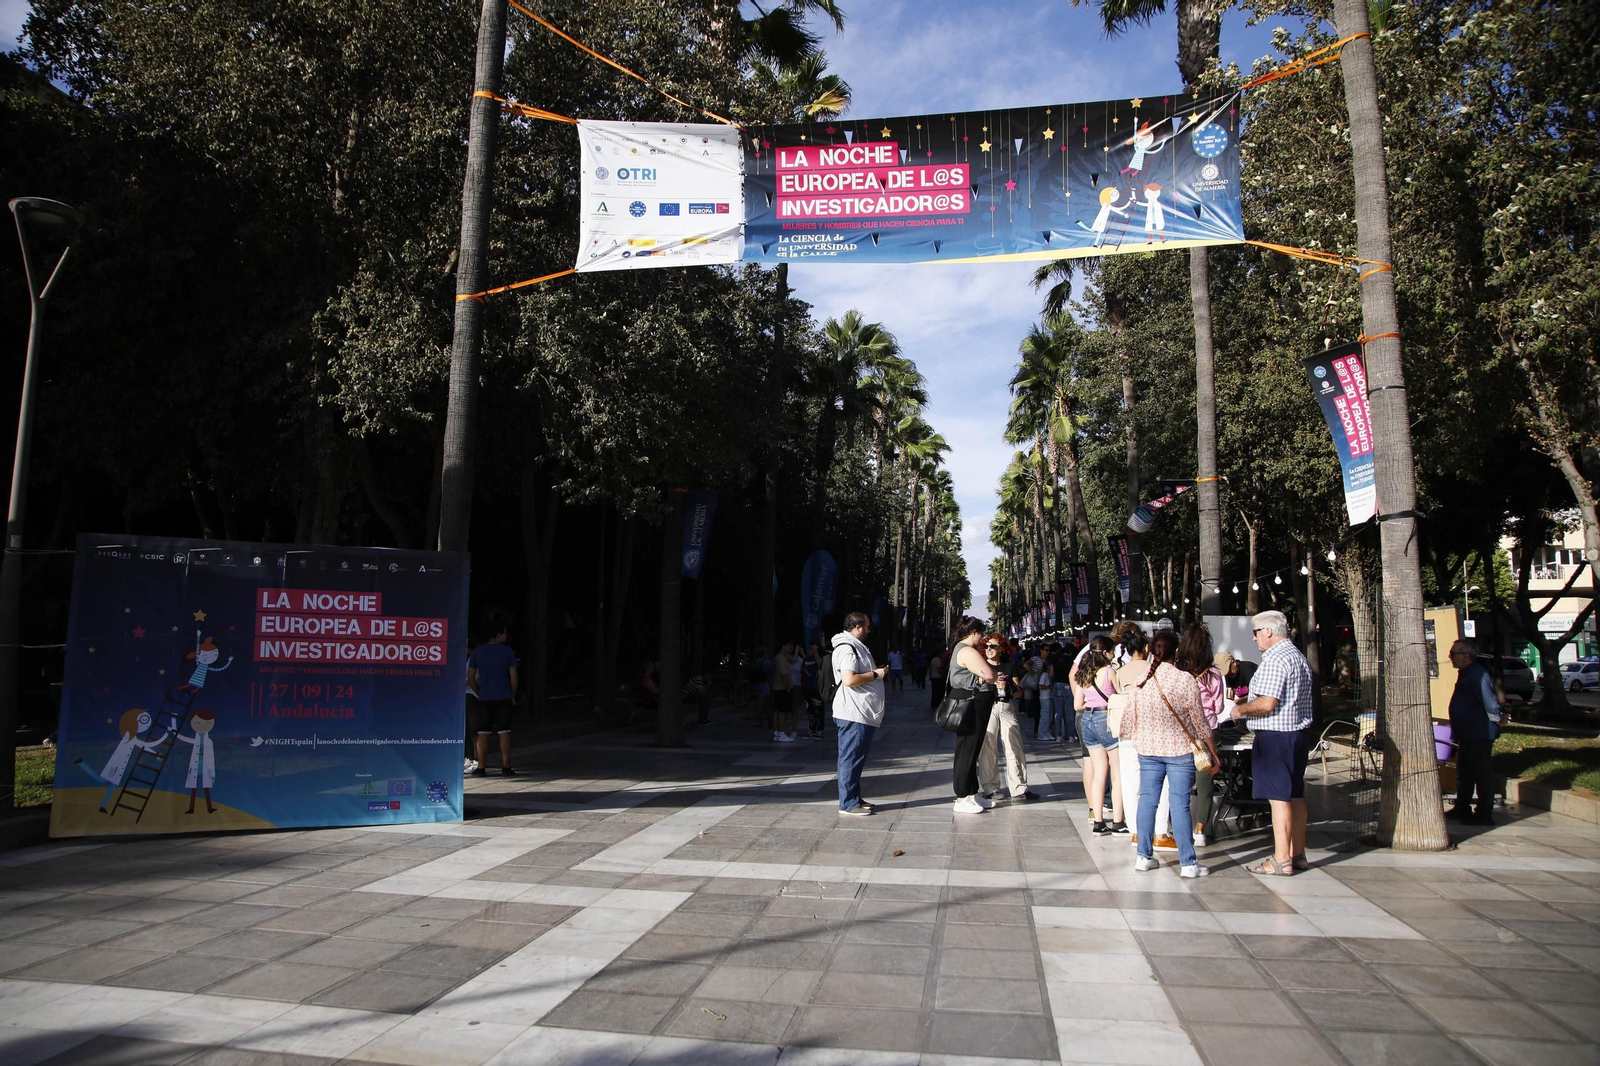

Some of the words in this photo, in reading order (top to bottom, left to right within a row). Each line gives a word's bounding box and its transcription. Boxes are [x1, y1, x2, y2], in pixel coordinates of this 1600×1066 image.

[781, 150, 808, 167] LA
[820, 146, 893, 166] NOCHE
[617, 168, 656, 180] OTRI
[782, 172, 879, 192] EUROPEA
[888, 170, 914, 188] DE
[921, 168, 964, 187] L@S
[782, 194, 964, 216] INVESTIGADOR@S
[879, 219, 904, 227] HACEN
[790, 243, 857, 251] UNIVERSIDAD
[791, 234, 831, 242] CIENCIA
[1335, 361, 1351, 383] L@S
[1344, 384, 1357, 399] DE
[1336, 398, 1355, 436] NOCHE
[1351, 401, 1369, 452] EUROPEA
[1350, 440, 1360, 455] LA
[690, 503, 701, 546] UNIVERSIDAD
[695, 537, 702, 547] DE
[812, 564, 829, 611] cajamar
[262, 591, 291, 609] LA
[303, 593, 377, 612] NOCHE
[261, 616, 362, 635] EUROPEA
[371, 619, 396, 636] DE
[402, 620, 443, 638] L@S
[260, 640, 442, 662] INVESTIGADOR@S
[268, 684, 288, 698] 27
[301, 684, 322, 698] 09
[335, 685, 354, 698] 24
[268, 703, 355, 718] Andalucía
[264, 738, 313, 746] #NIGHTspain
